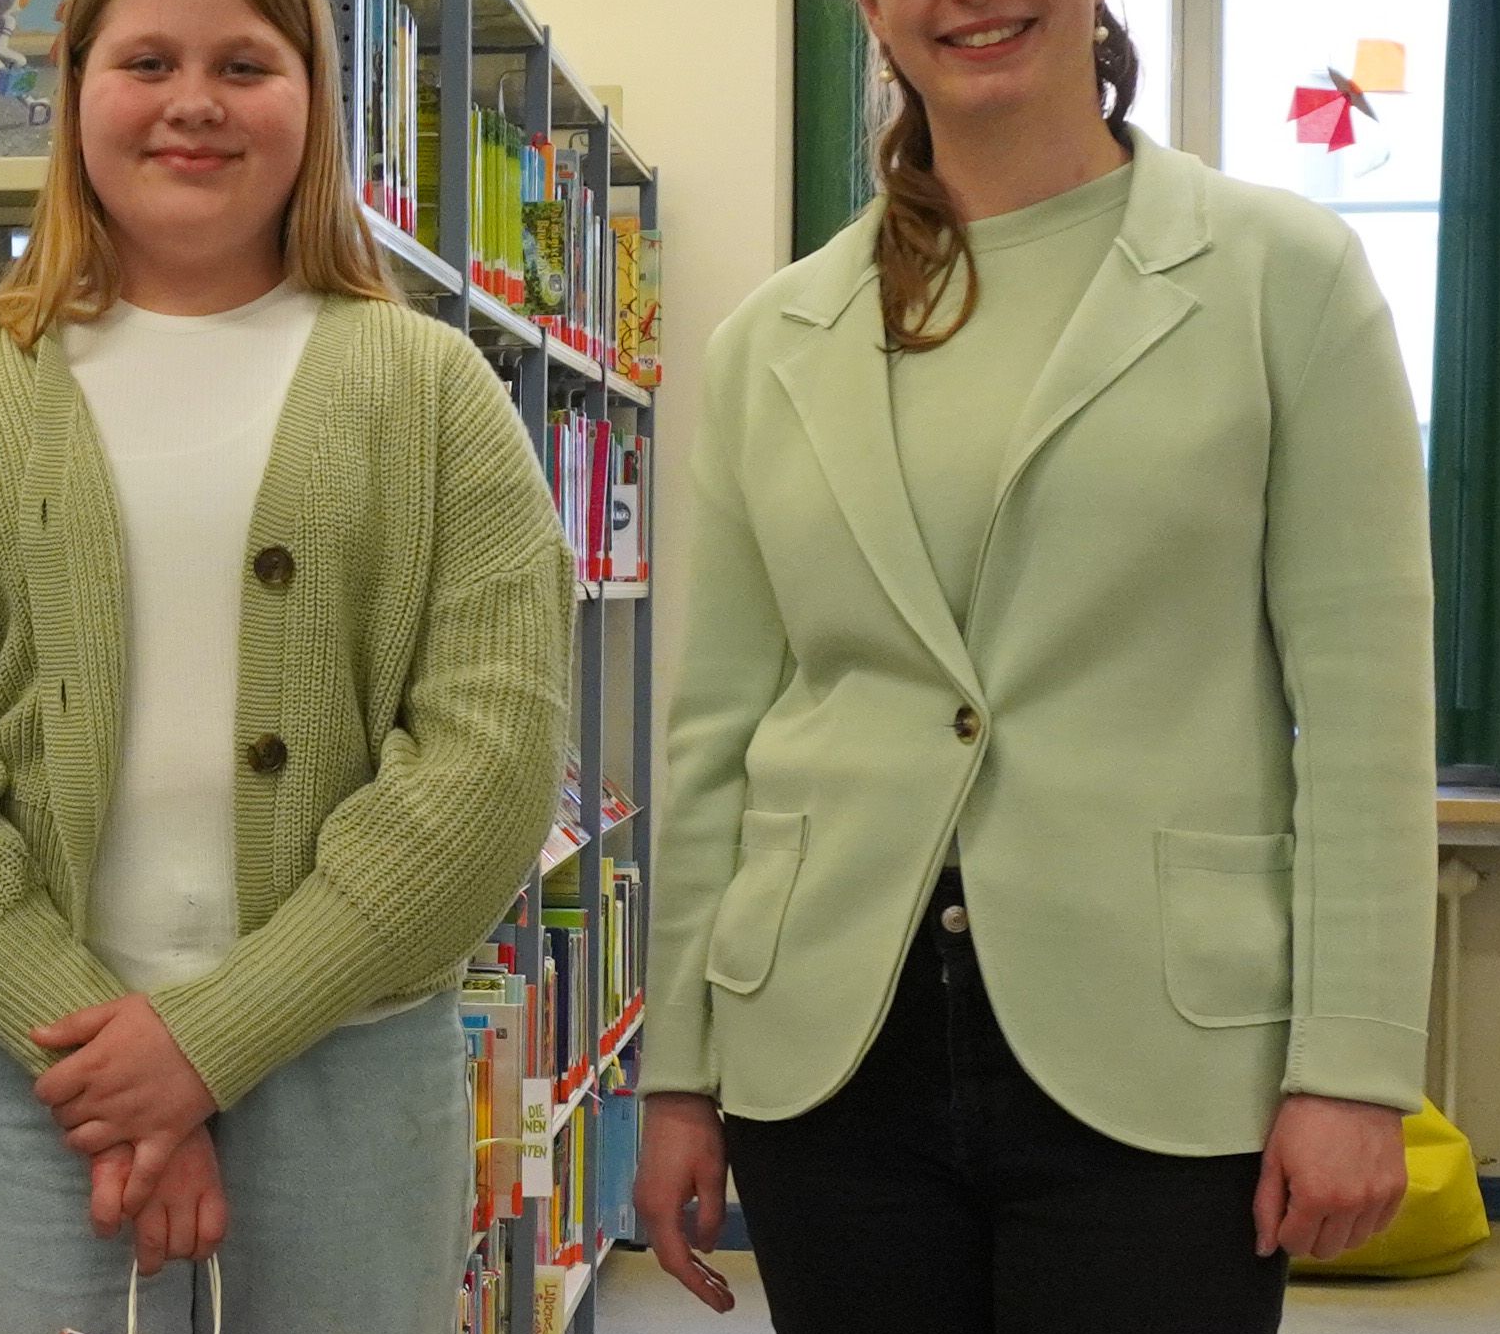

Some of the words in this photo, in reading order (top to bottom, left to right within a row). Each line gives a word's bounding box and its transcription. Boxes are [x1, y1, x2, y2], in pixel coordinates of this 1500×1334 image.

[527, 1104, 546, 1119] DIE
[524, 1119, 547, 1134] NEN
[521, 1145, 548, 1158] ATEN
